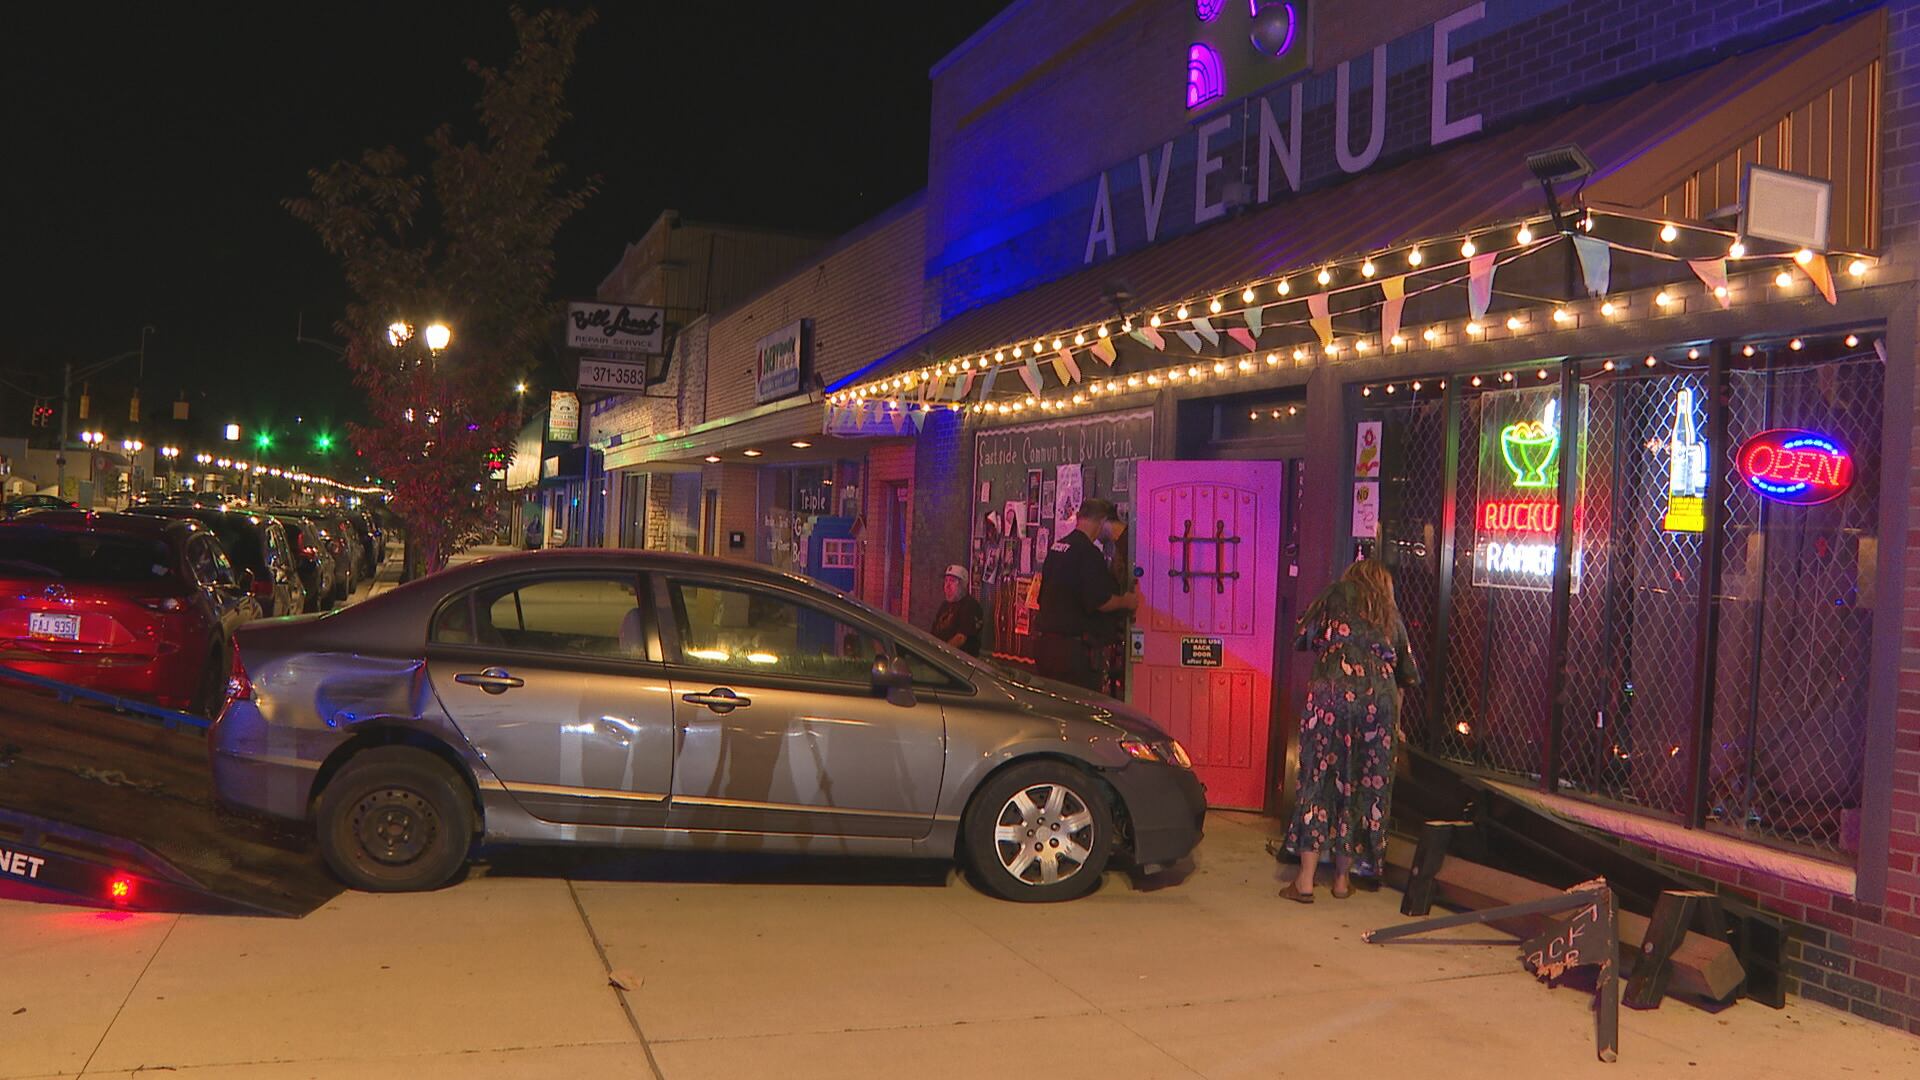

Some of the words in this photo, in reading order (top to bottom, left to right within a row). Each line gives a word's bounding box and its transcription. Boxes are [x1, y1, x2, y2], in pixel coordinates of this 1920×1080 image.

[1084, 1, 1486, 264] AVENUE
[571, 308, 611, 330] Bill
[575, 335, 609, 346] REPAIR
[593, 366, 644, 385] 371-3583
[1748, 445, 1845, 486] OPEN
[800, 488, 826, 515] Triple
[1484, 503, 1559, 532] RUCKU
[32, 619, 50, 632] FAJ
[0, 849, 45, 878] NET
